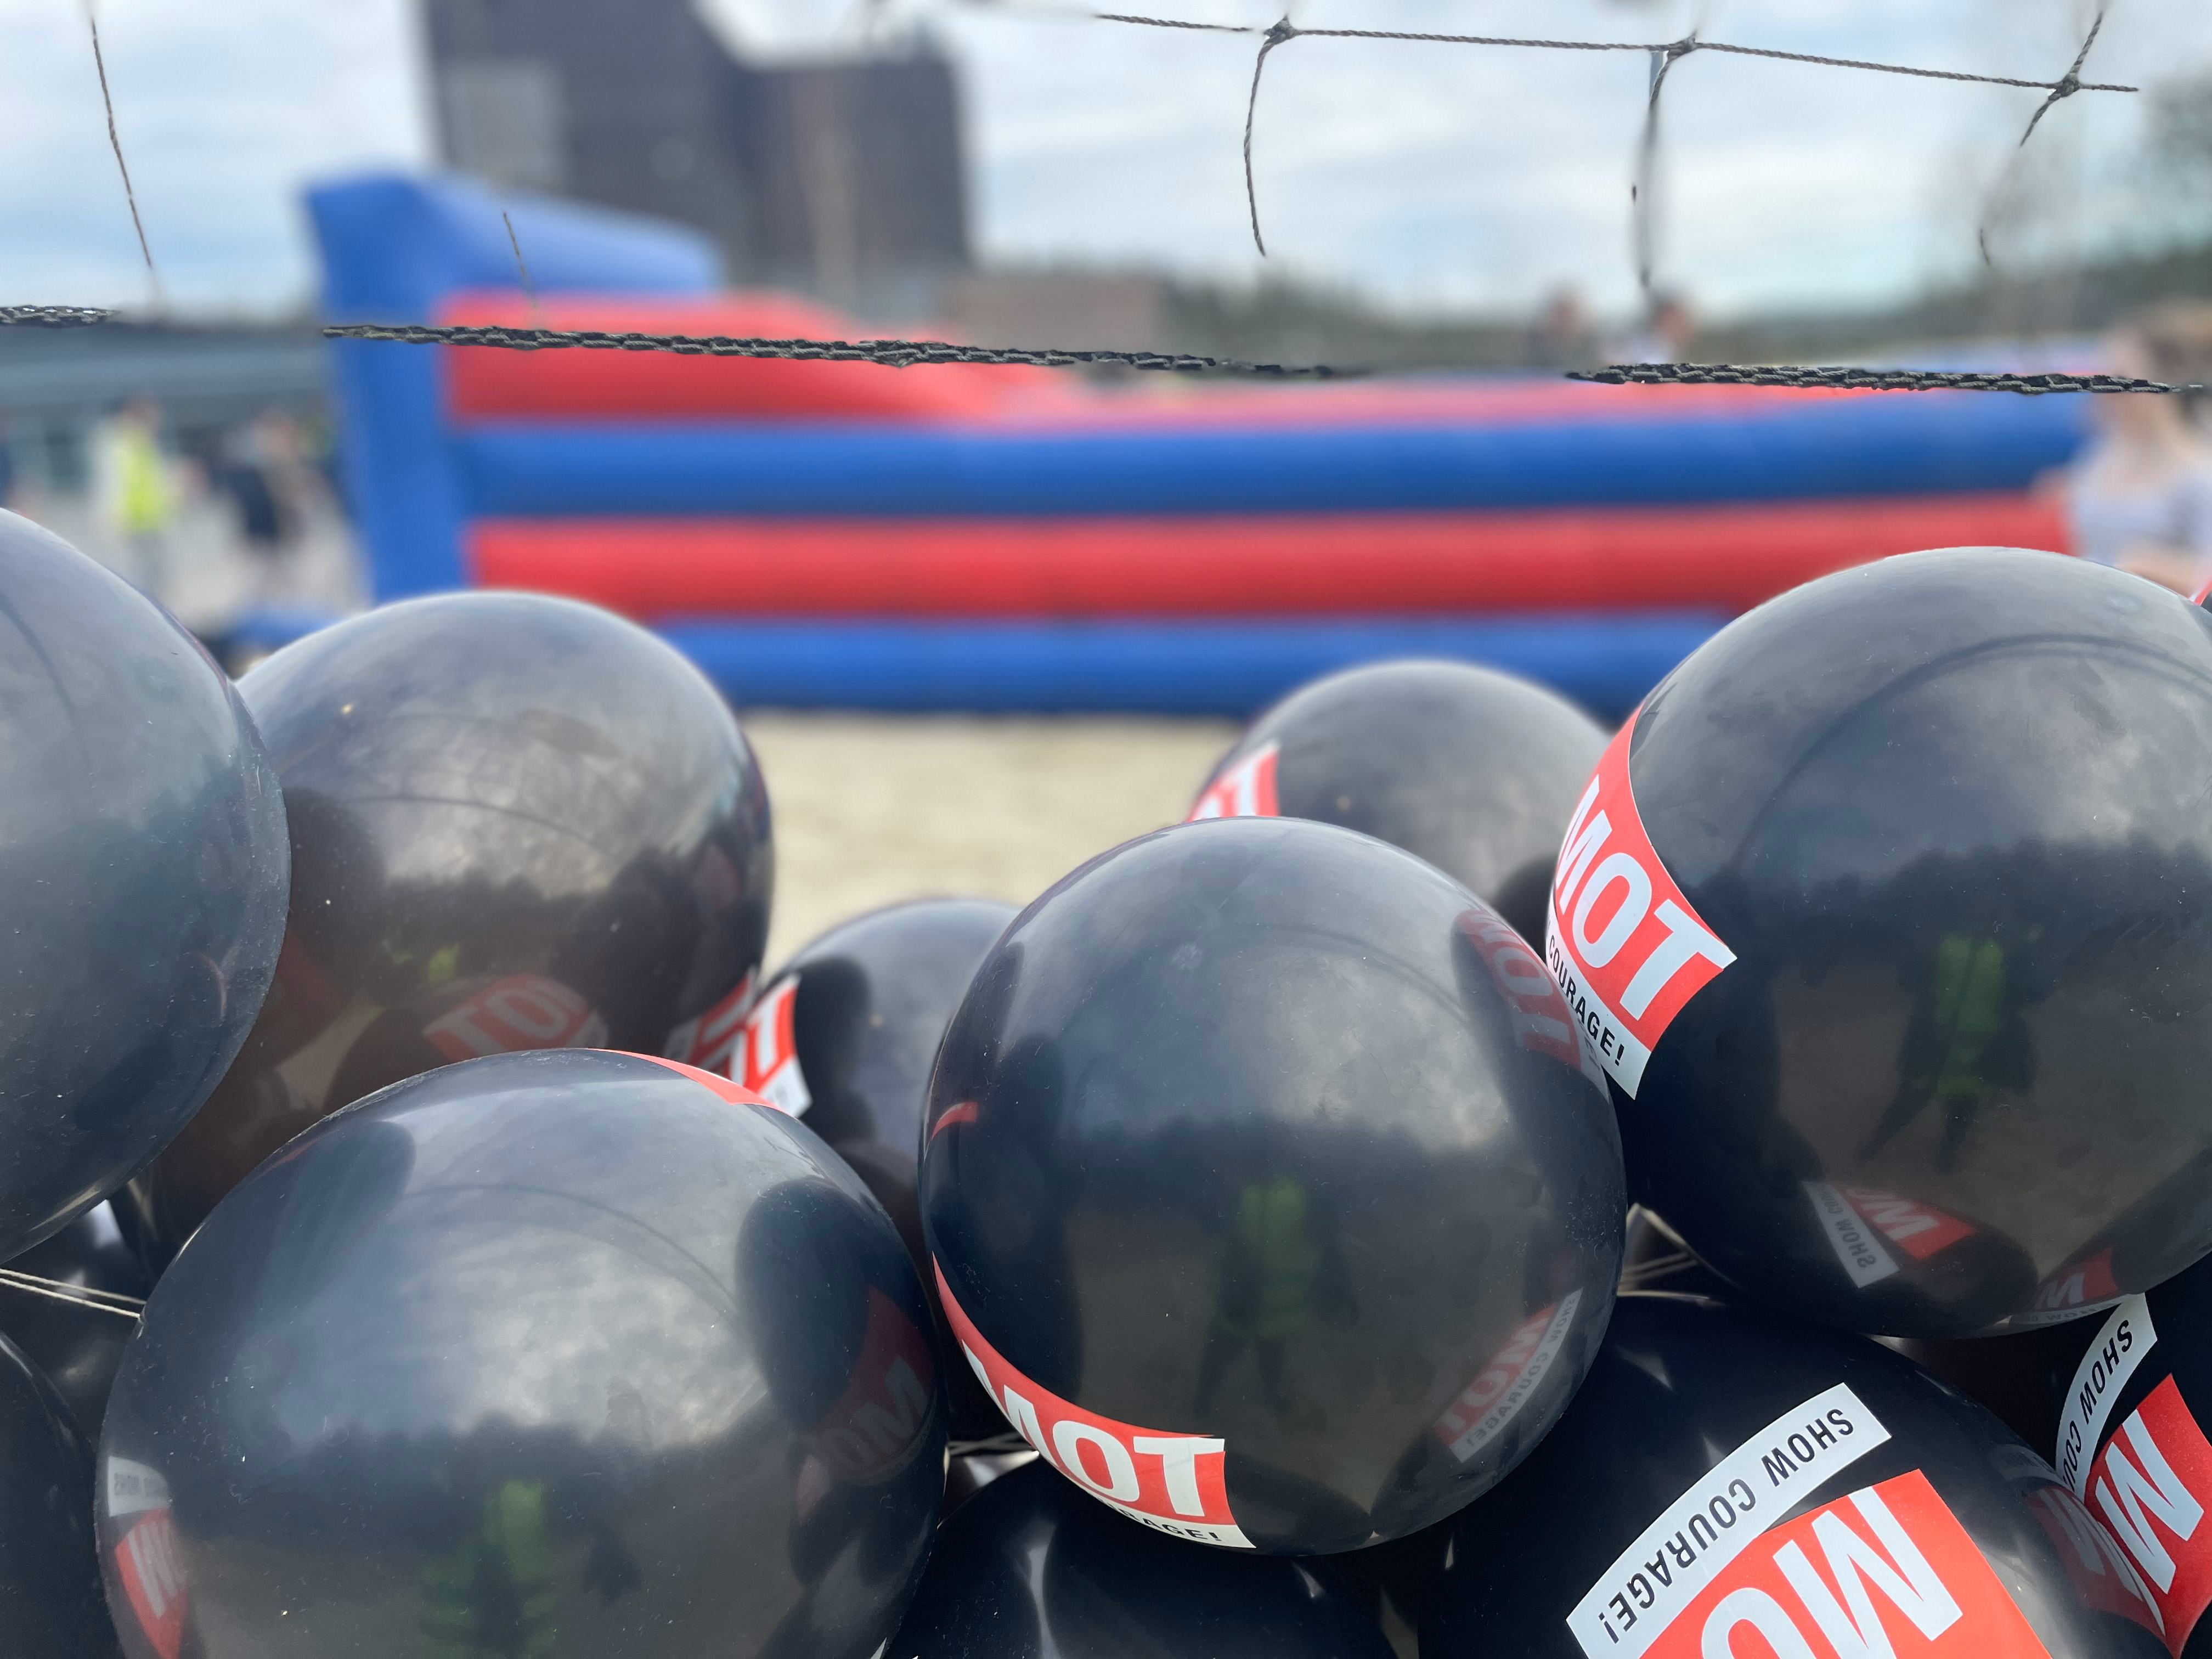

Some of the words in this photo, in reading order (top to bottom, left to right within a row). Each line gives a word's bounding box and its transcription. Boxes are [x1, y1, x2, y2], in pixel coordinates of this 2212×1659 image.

[1556, 773, 1737, 1021] MOT
[1549, 934, 1624, 1066] COURAGE!
[2080, 1319, 2134, 1425] SHOW
[1761, 1408, 1854, 1487] SHOW
[1598, 1479, 1757, 1644] COURAGE!
